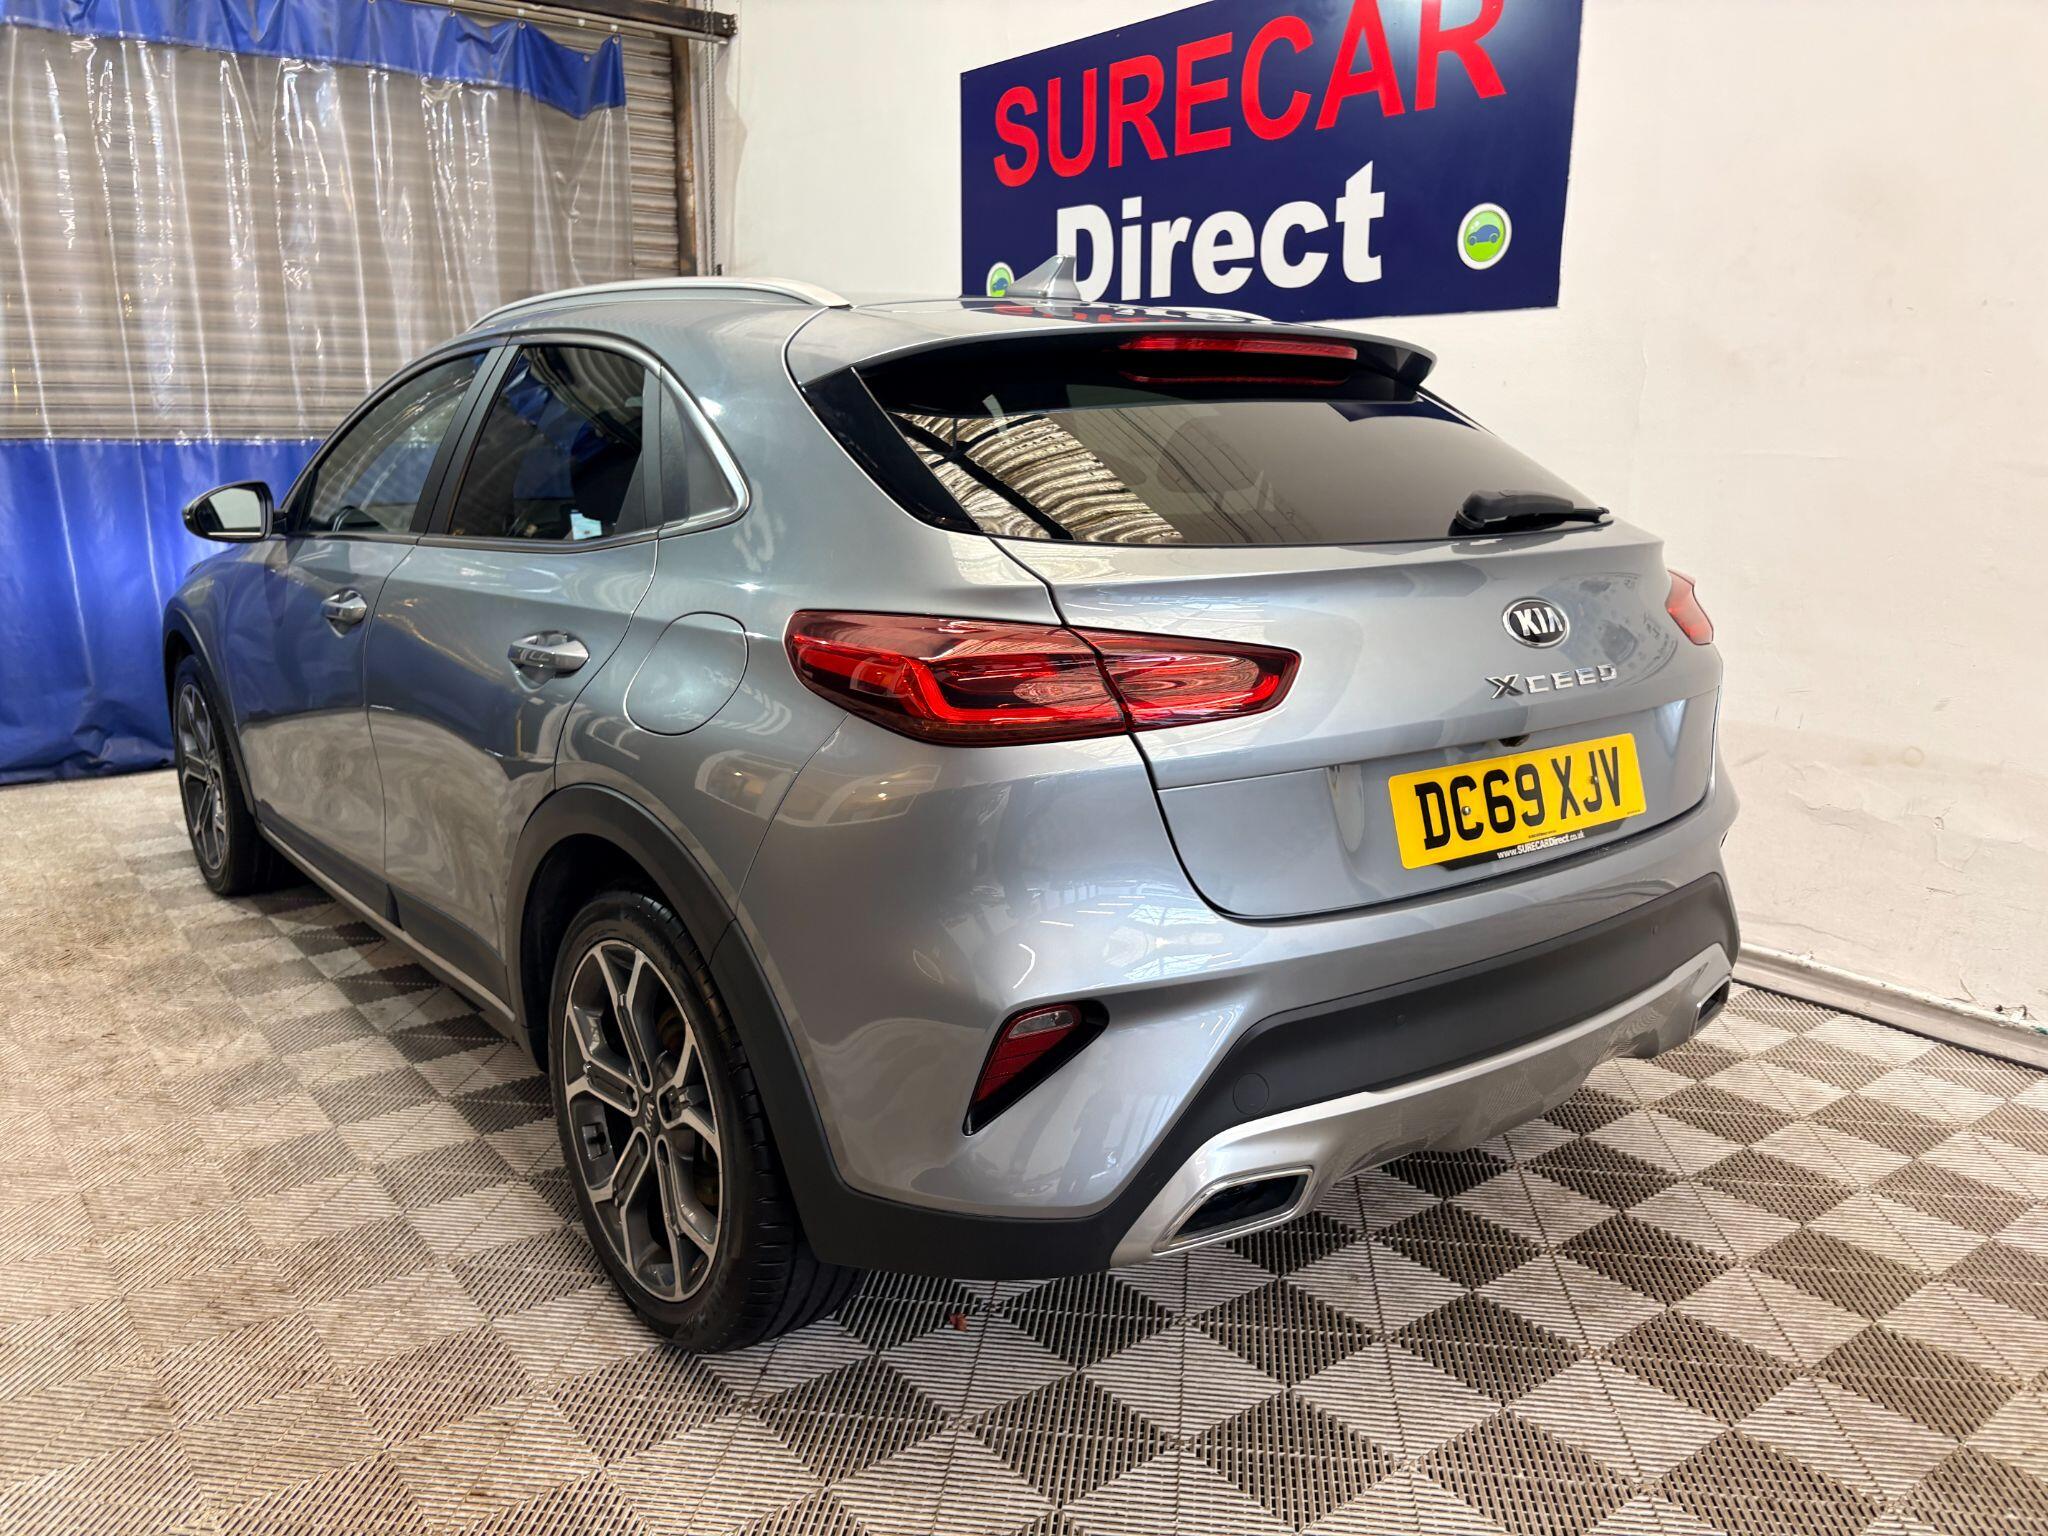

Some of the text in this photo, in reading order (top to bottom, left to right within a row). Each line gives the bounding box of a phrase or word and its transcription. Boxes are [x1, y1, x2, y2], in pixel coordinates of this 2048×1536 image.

[993, 0, 1507, 188] SURECAR
[1056, 160, 1386, 303] Direct
[1513, 606, 1565, 637] KIA
[1485, 663, 1618, 700] XCEED
[1414, 746, 1622, 851] DC69 XJV
